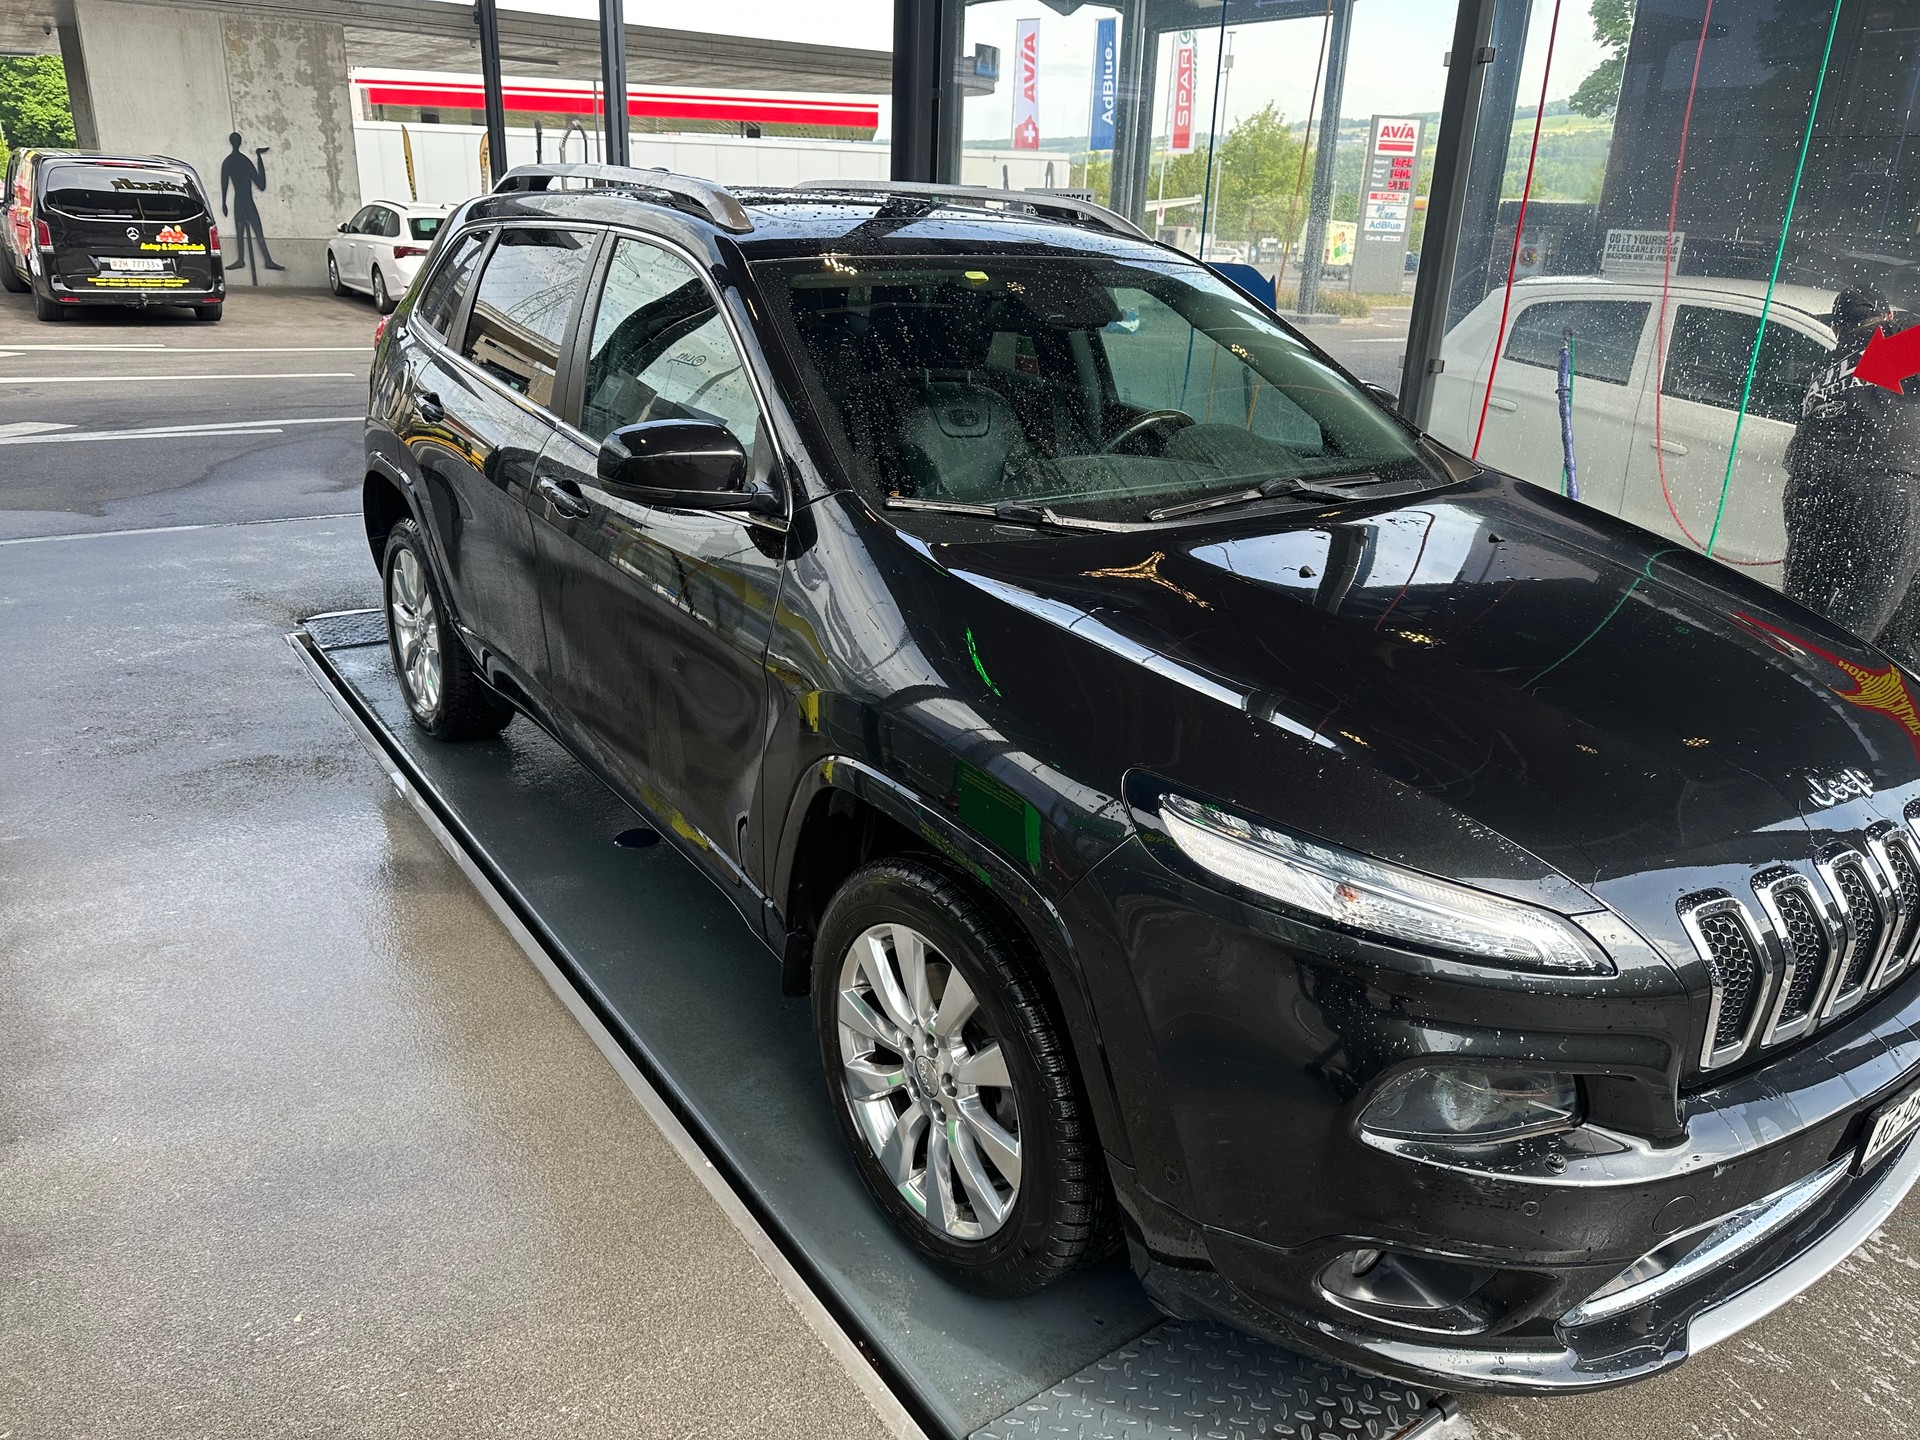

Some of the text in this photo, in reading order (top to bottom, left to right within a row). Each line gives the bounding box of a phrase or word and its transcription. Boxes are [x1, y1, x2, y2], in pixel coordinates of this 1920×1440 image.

[1178, 50, 1190, 126] SPAR
[1380, 123, 1415, 139] AVIA
[1369, 221, 1402, 229] AdBlue
[1609, 233, 1622, 244] DO
[1634, 234, 1680, 246] YOURSEF
[118, 260, 128, 268] ZH
[1804, 768, 1873, 809] Jeep
[1869, 1107, 1902, 1155] AG
